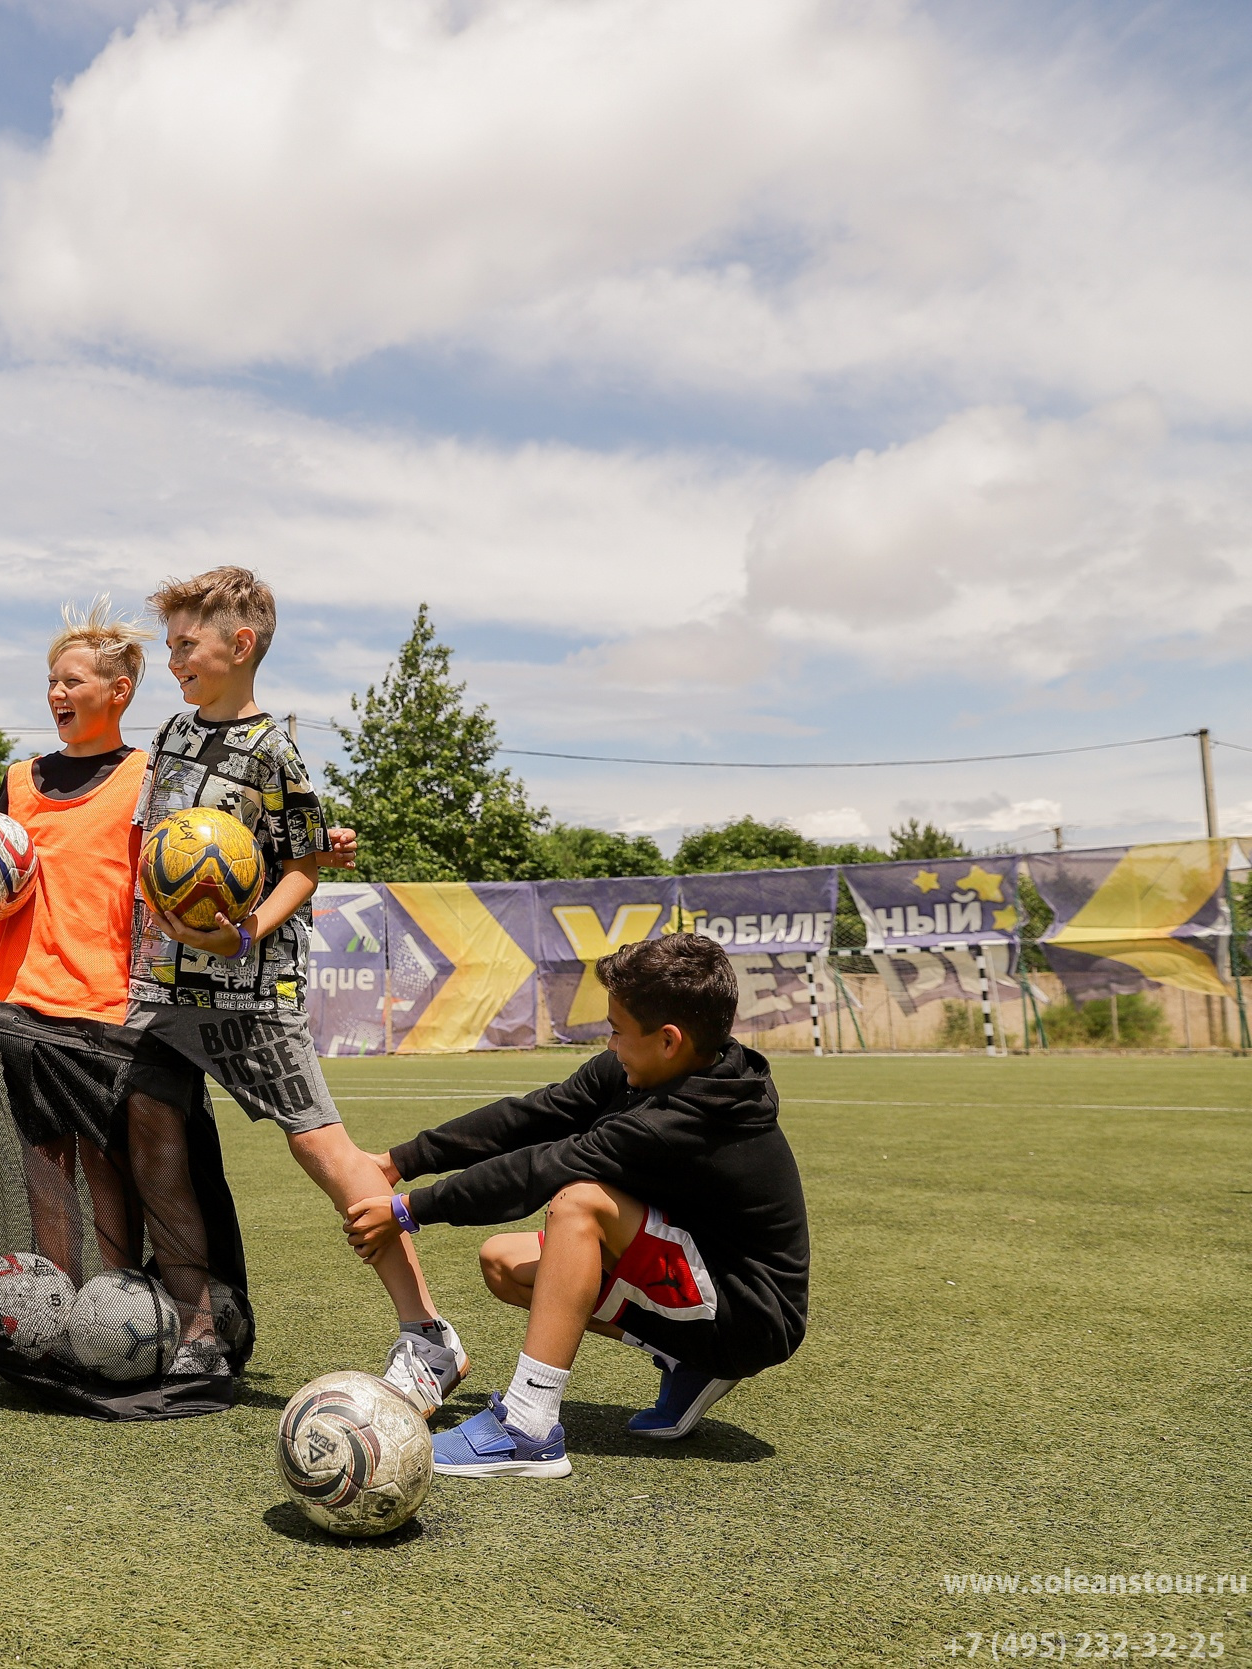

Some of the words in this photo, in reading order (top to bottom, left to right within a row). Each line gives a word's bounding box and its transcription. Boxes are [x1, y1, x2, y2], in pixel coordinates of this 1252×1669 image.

[214, 1000, 236, 1010] THE
[236, 1000, 275, 1010] RULES
[215, 991, 255, 1000] BREAK
[199, 1012, 286, 1055] BORN
[211, 1053, 255, 1085] TO
[253, 1040, 301, 1080] BE
[305, 1427, 338, 1455] PEAK
